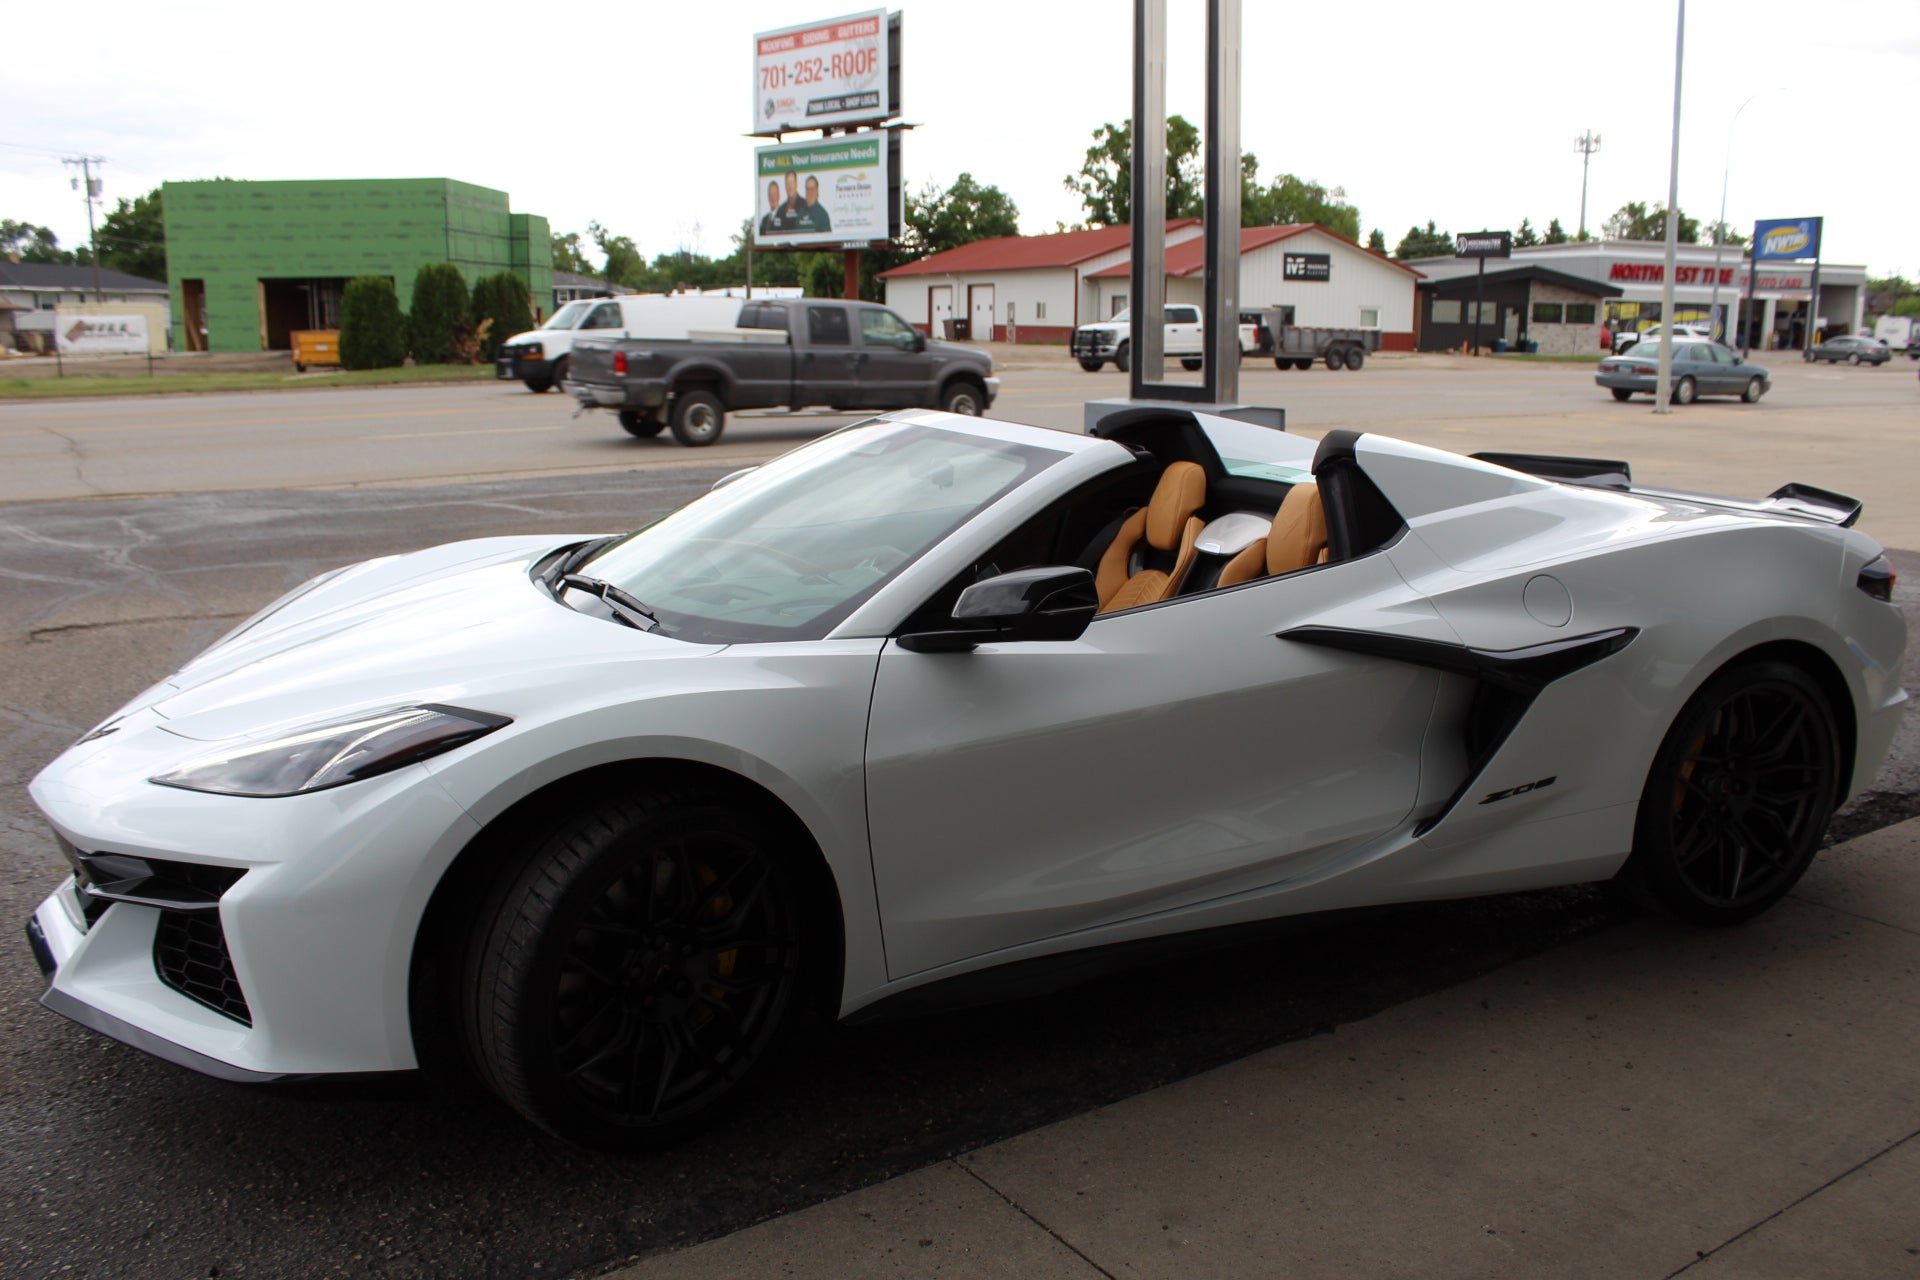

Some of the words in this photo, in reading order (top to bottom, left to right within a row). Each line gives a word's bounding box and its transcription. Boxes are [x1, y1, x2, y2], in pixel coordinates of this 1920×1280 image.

[761, 36, 795, 53] ROOFING
[802, 29, 830, 46] SIDING
[838, 21, 877, 38] GUTTERS
[760, 48, 878, 90] 701-252-ROOF
[824, 99, 841, 111] LOCAL
[844, 97, 860, 109] SHOP
[860, 93, 878, 107] LOCAL
[763, 156, 776, 169] For
[776, 154, 791, 167] ALL
[791, 153, 810, 166] Your
[810, 149, 850, 163] Insurance
[850, 145, 877, 159] Needs
[1610, 263, 1699, 284] NORTHEST
[1703, 267, 1734, 285] TIRE
[1757, 276, 1777, 288] UTO
